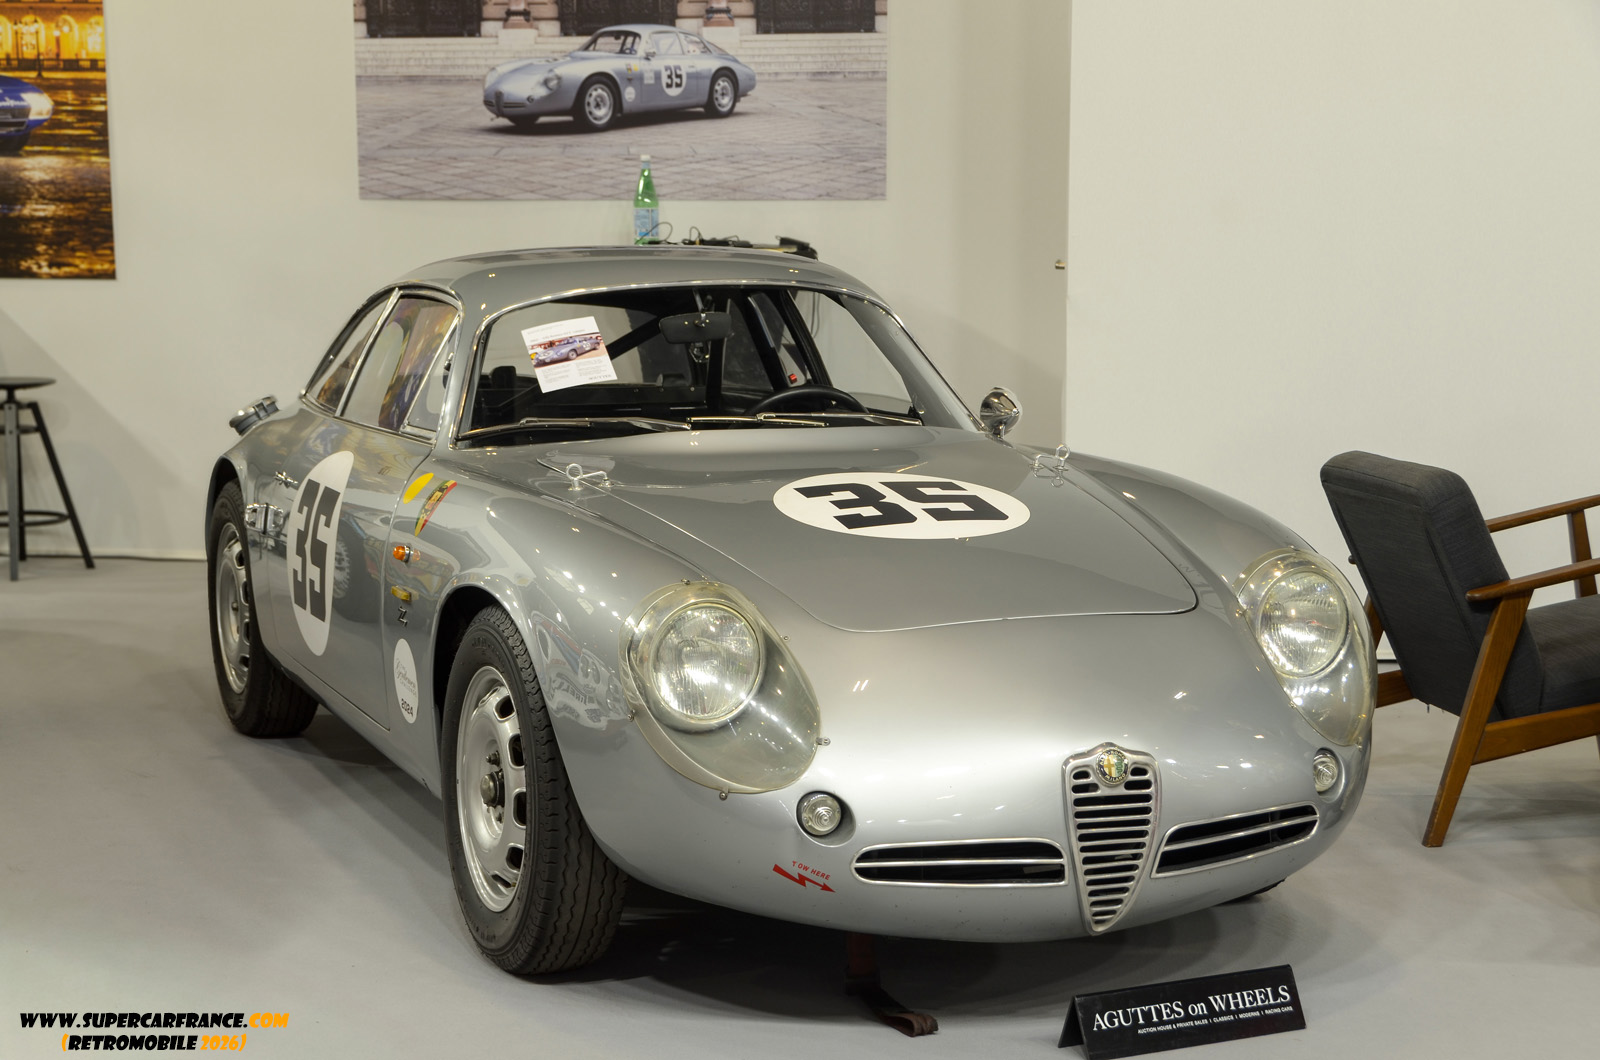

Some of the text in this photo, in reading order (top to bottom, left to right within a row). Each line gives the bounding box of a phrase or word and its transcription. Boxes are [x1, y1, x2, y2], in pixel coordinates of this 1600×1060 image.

[664, 65, 683, 88] 35
[793, 481, 1009, 530] 35
[293, 478, 341, 623] 35
[401, 698, 414, 717] 2024
[792, 860, 831, 881] TOW HERE
[1092, 984, 1291, 1031] AGUTTES on WHEELS
[1213, 1015, 1234, 1023] CLASSICS
[1239, 1011, 1260, 1019] MODERNS
